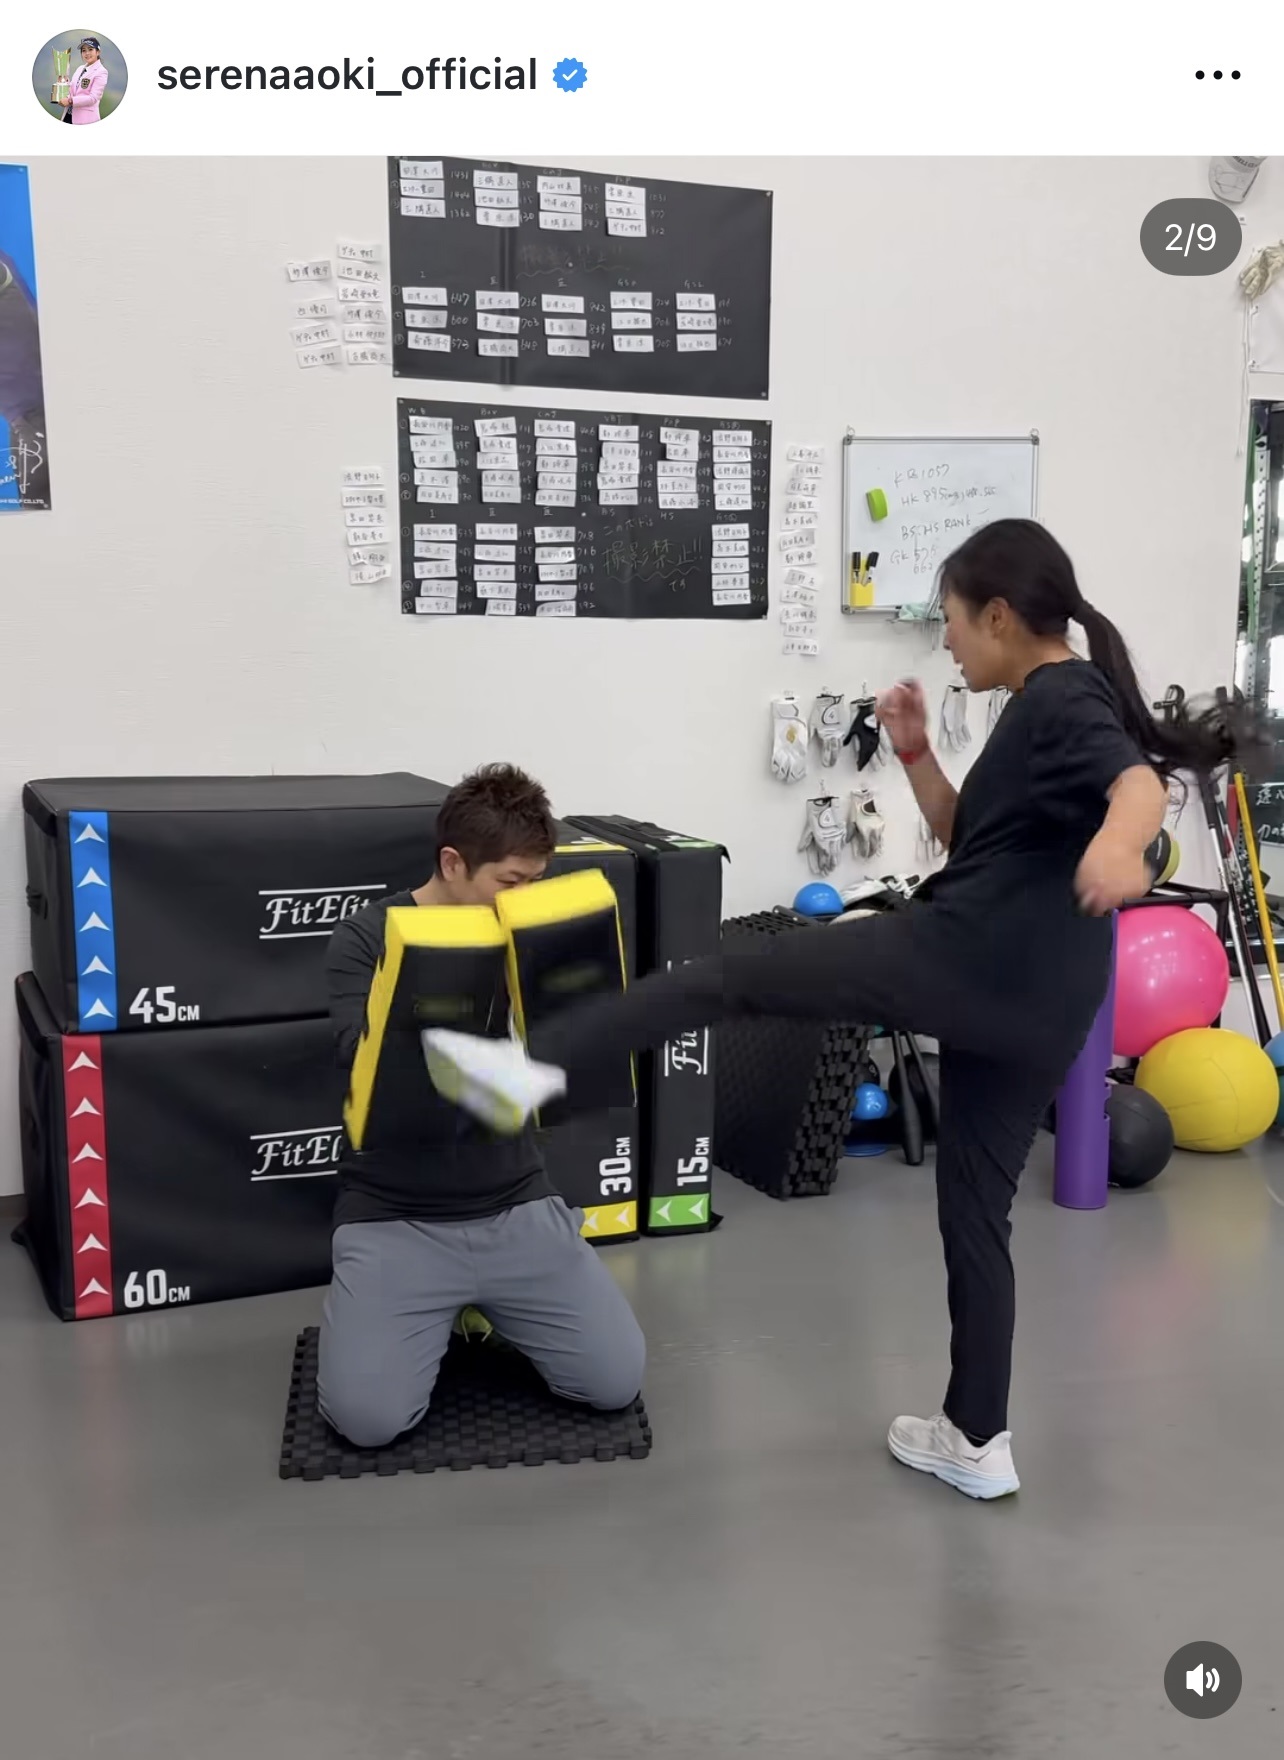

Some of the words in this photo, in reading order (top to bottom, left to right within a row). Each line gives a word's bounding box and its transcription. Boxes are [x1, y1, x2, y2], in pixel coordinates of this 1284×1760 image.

[128, 985, 200, 1024] 45CM
[599, 1136, 632, 1196] 30CM
[676, 1136, 710, 1187] 15CM
[123, 1268, 191, 1309] 60CM
